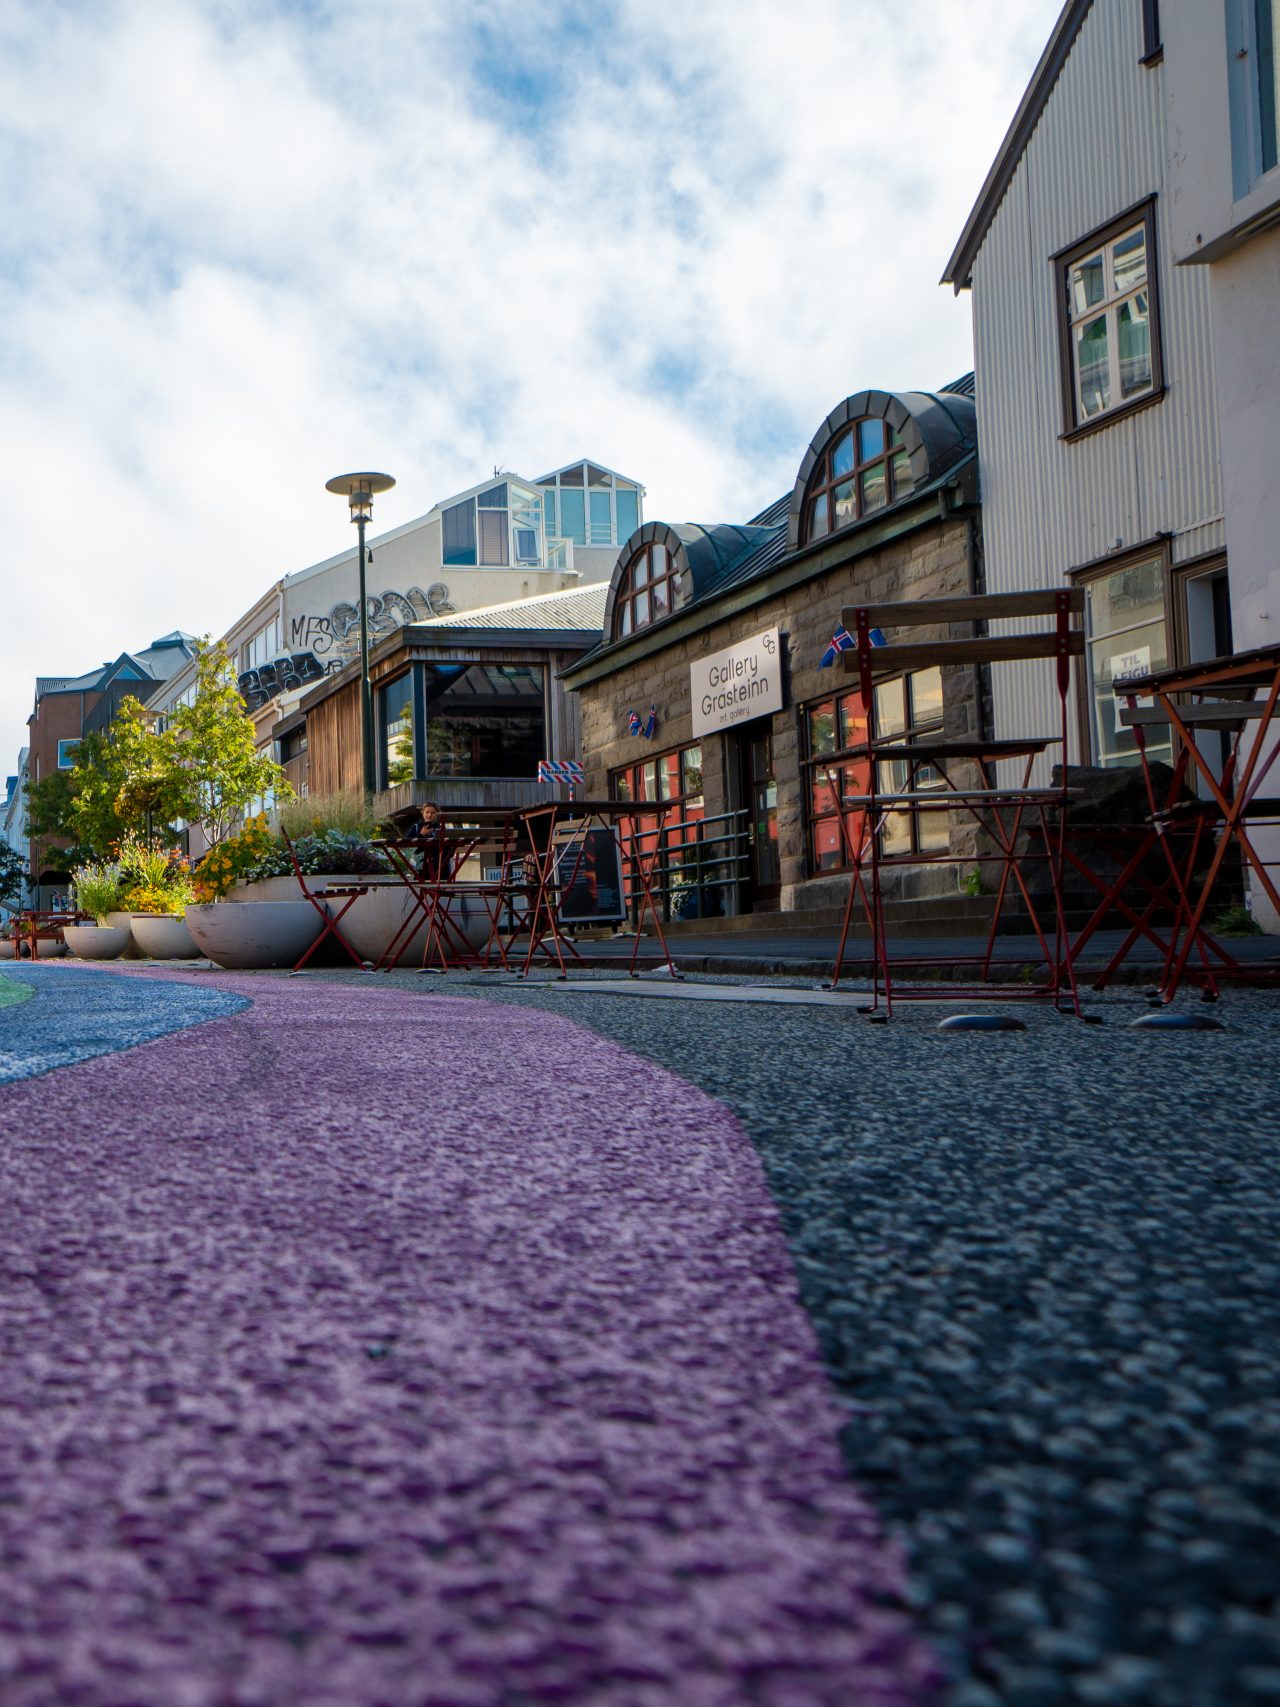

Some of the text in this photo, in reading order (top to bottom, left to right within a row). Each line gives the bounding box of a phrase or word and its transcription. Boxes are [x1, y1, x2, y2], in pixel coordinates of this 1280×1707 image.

[708, 654, 758, 688] Gallery
[1121, 654, 1141, 669] TIL
[701, 676, 770, 716] Grásteinn
